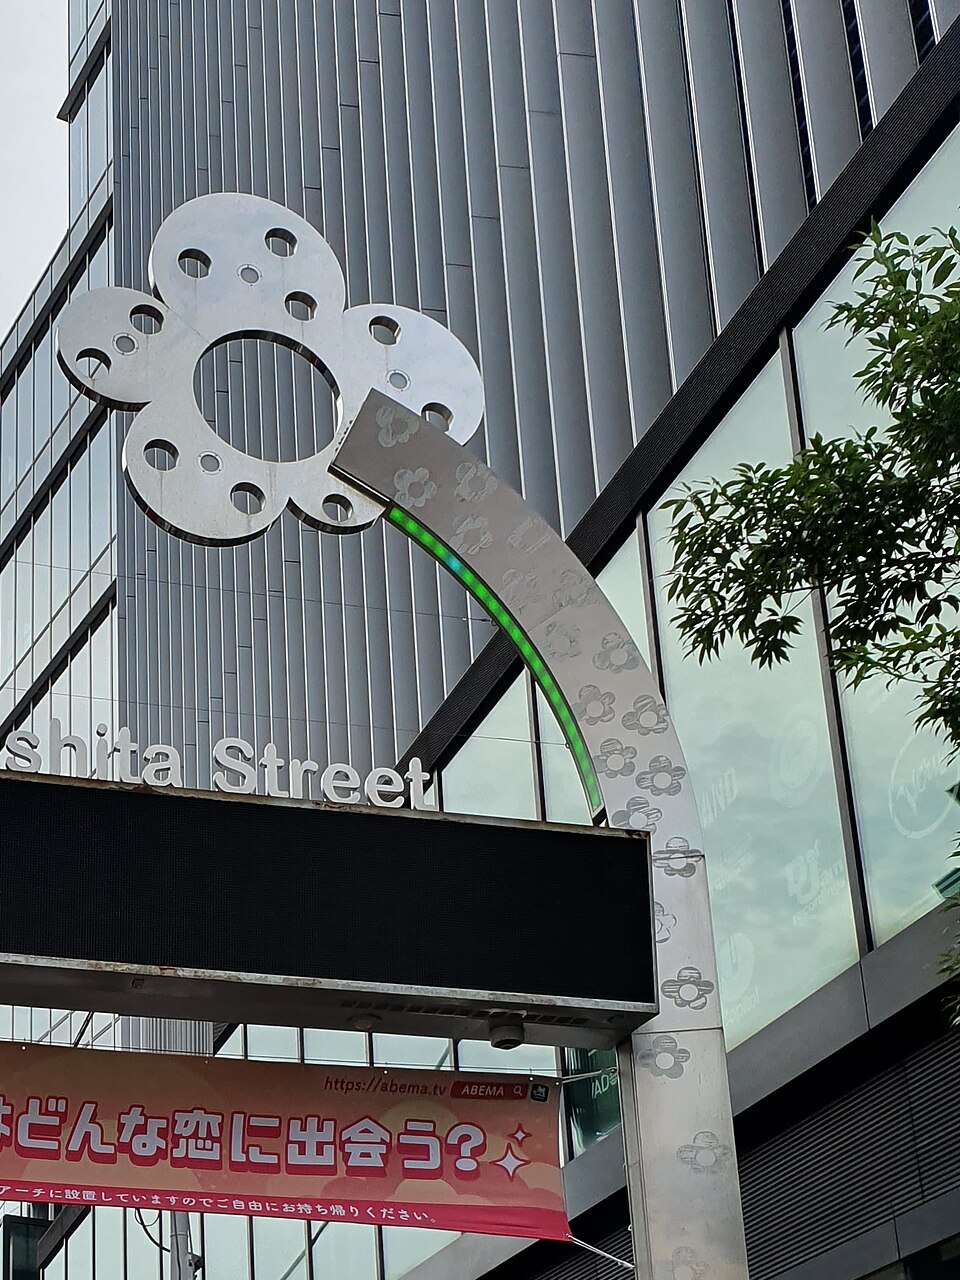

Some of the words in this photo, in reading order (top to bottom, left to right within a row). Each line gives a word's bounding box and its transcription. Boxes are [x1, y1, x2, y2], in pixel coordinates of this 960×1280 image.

[211, 736, 438, 811] Street
[323, 1075, 448, 1097] https://abema.tv
[460, 1084, 505, 1097] ABEMA
